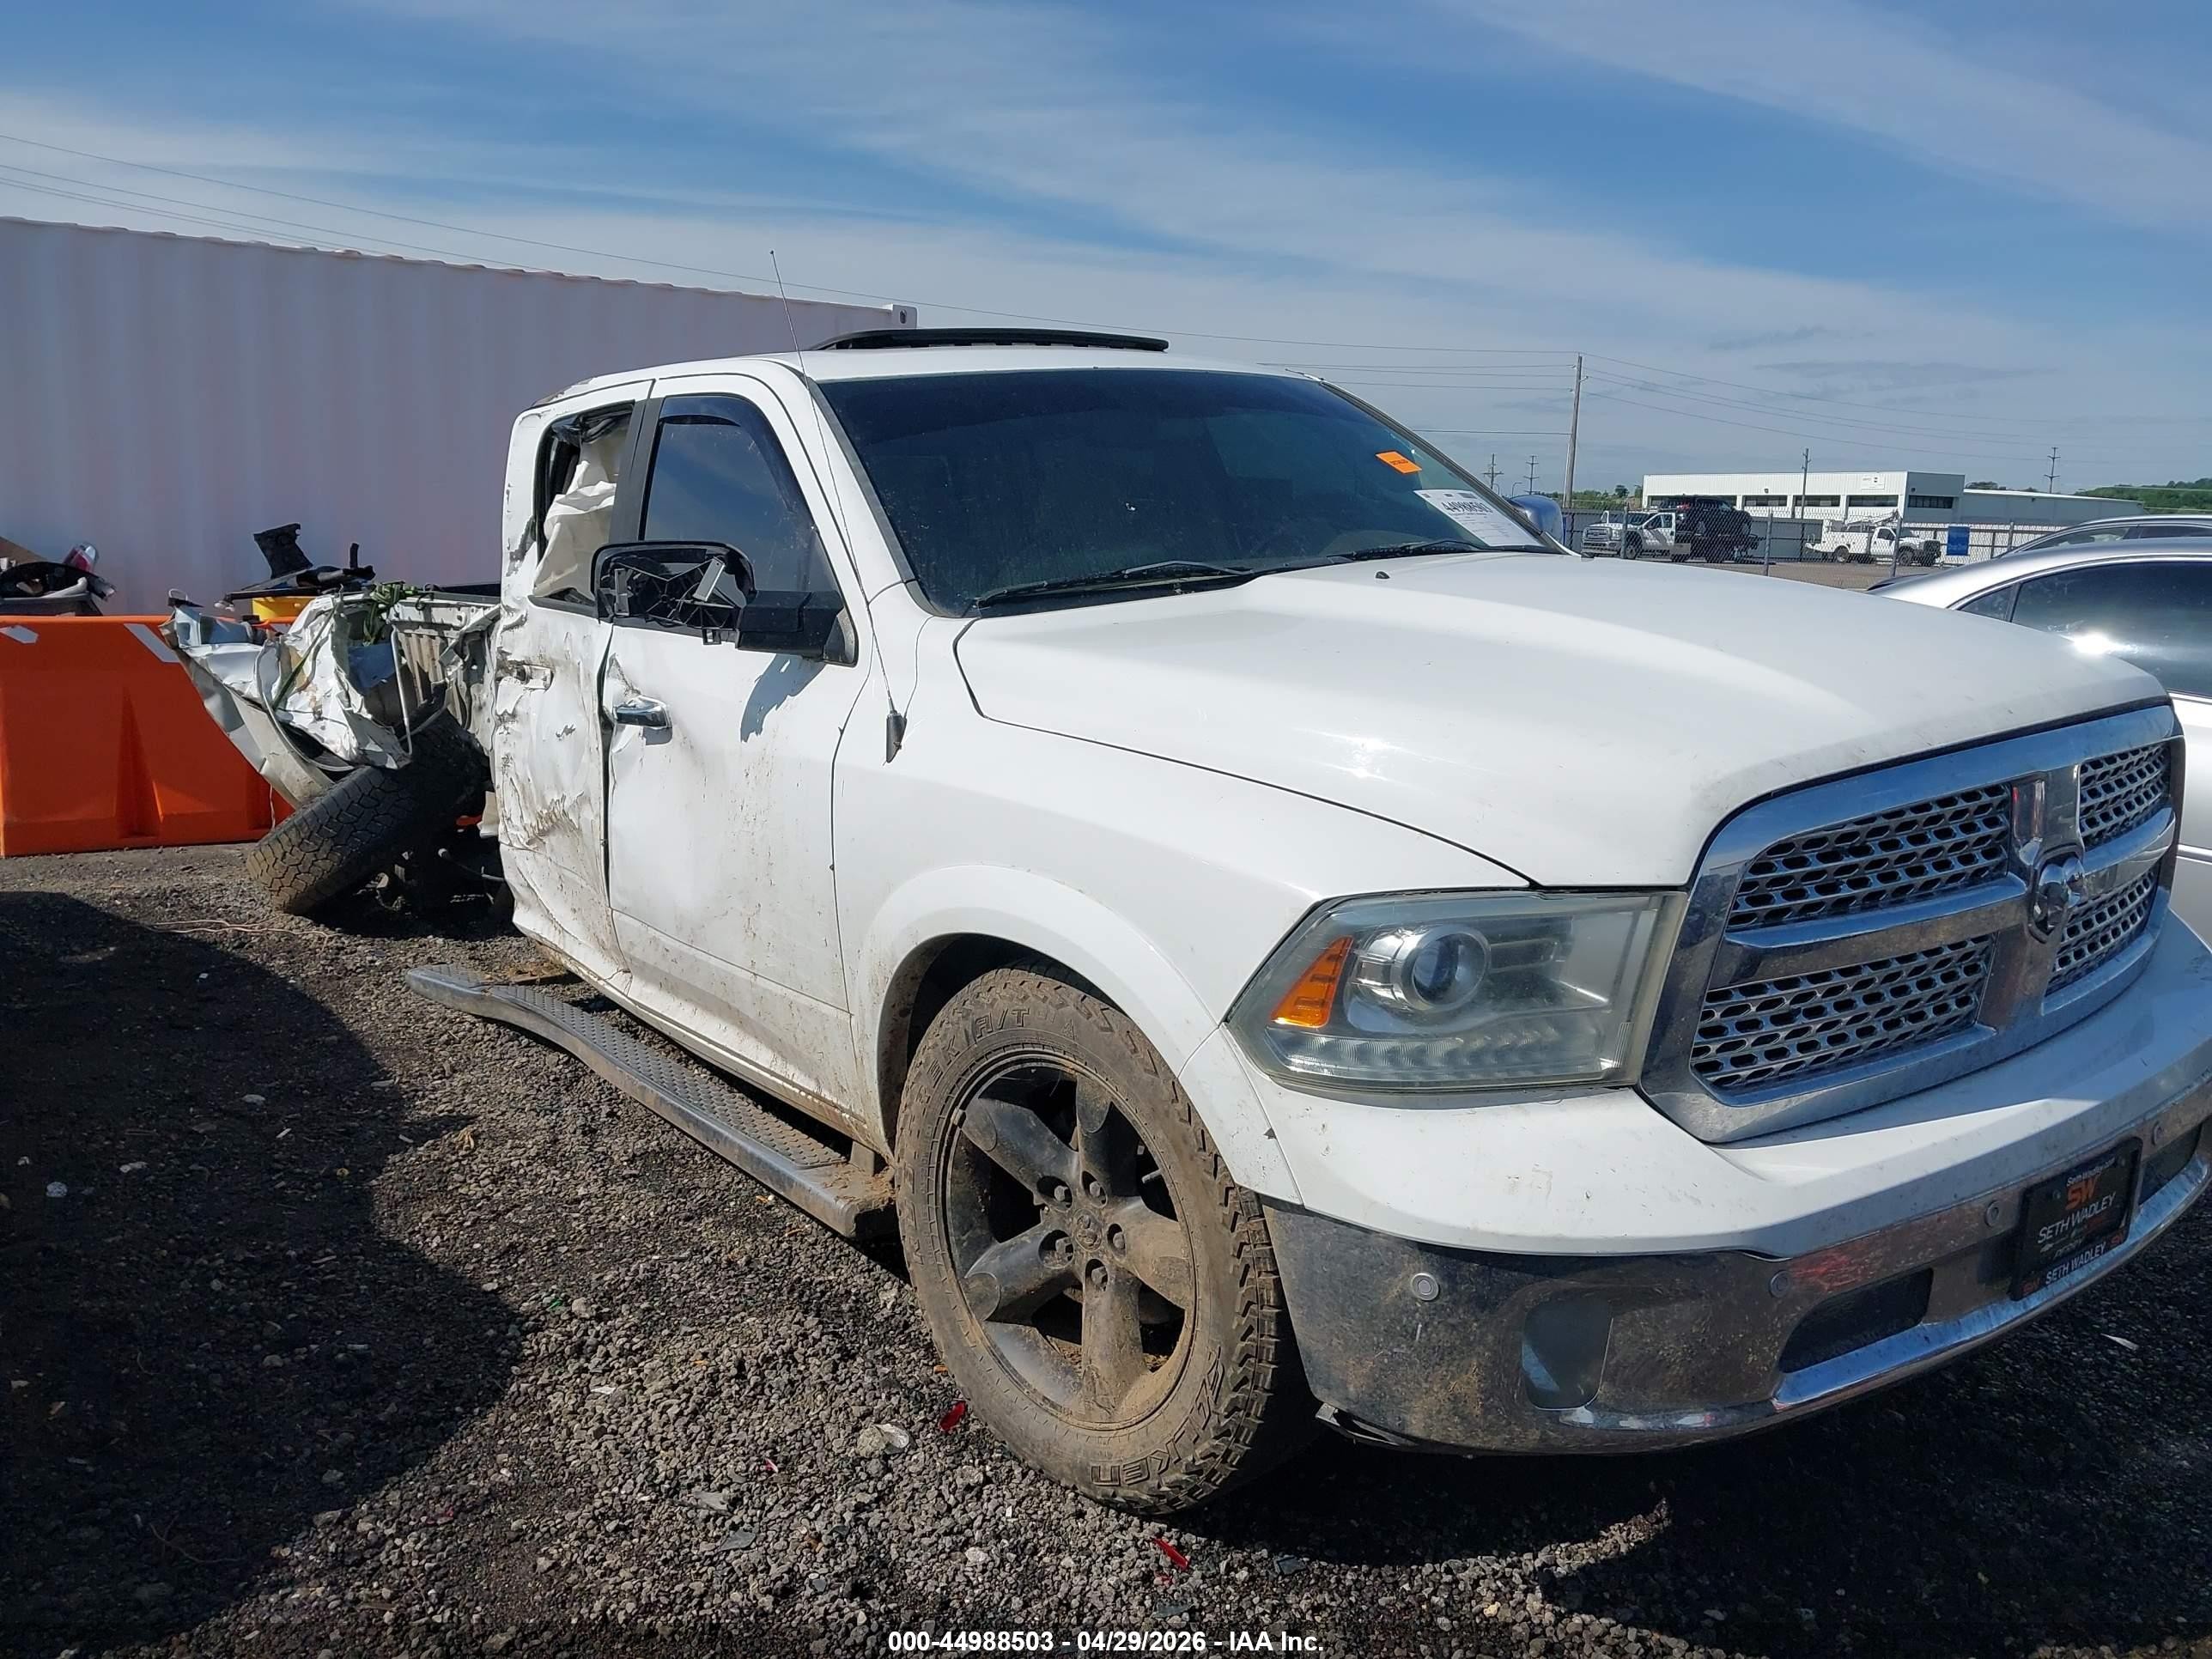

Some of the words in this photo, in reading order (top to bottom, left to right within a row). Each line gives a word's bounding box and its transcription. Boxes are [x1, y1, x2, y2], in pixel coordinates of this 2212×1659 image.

[2037, 1215, 2070, 1244] SETH
[2071, 1190, 2117, 1228] WADLEY
[2045, 1261, 2069, 1285] SETH
[2070, 1241, 2107, 1271] WADLEY
